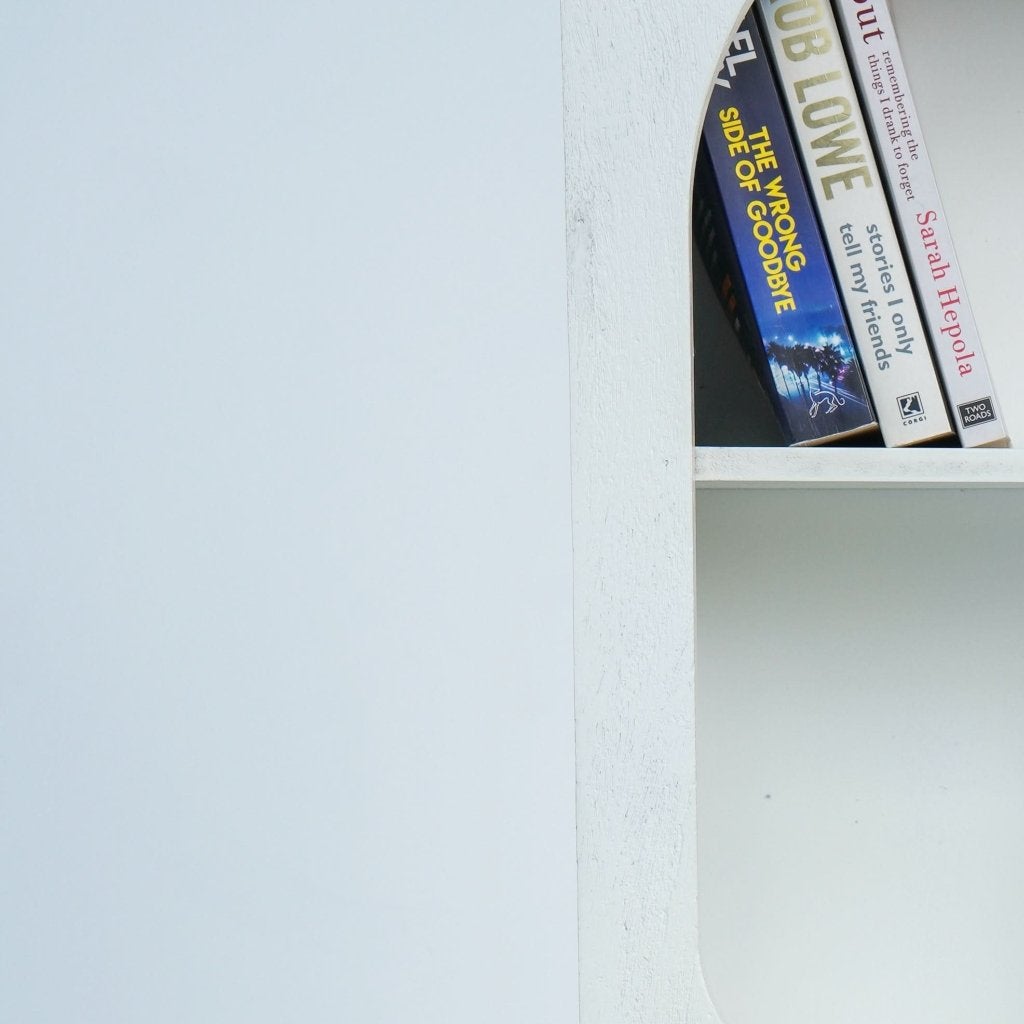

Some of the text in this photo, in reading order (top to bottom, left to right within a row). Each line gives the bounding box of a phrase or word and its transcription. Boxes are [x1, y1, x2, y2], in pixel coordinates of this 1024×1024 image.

[867, 54, 885, 96] things
[770, 0, 873, 200] OB LOWE
[882, 50, 919, 161] remembering the
[719, 106, 750, 157] SIDE
[882, 106, 901, 145] drank
[893, 145, 903, 160] to
[735, 160, 761, 192] OF
[748, 125, 806, 272] THE WRONG
[897, 162, 915, 202] forget
[747, 200, 797, 314] GOODBYE
[839, 222, 892, 371] tell my friends
[866, 223, 914, 355] stories I only
[916, 210, 976, 377] Sarah Hepola
[903, 416, 927, 426] CORGI
[964, 410, 992, 423] ROADS
[965, 404, 986, 415] TWO
